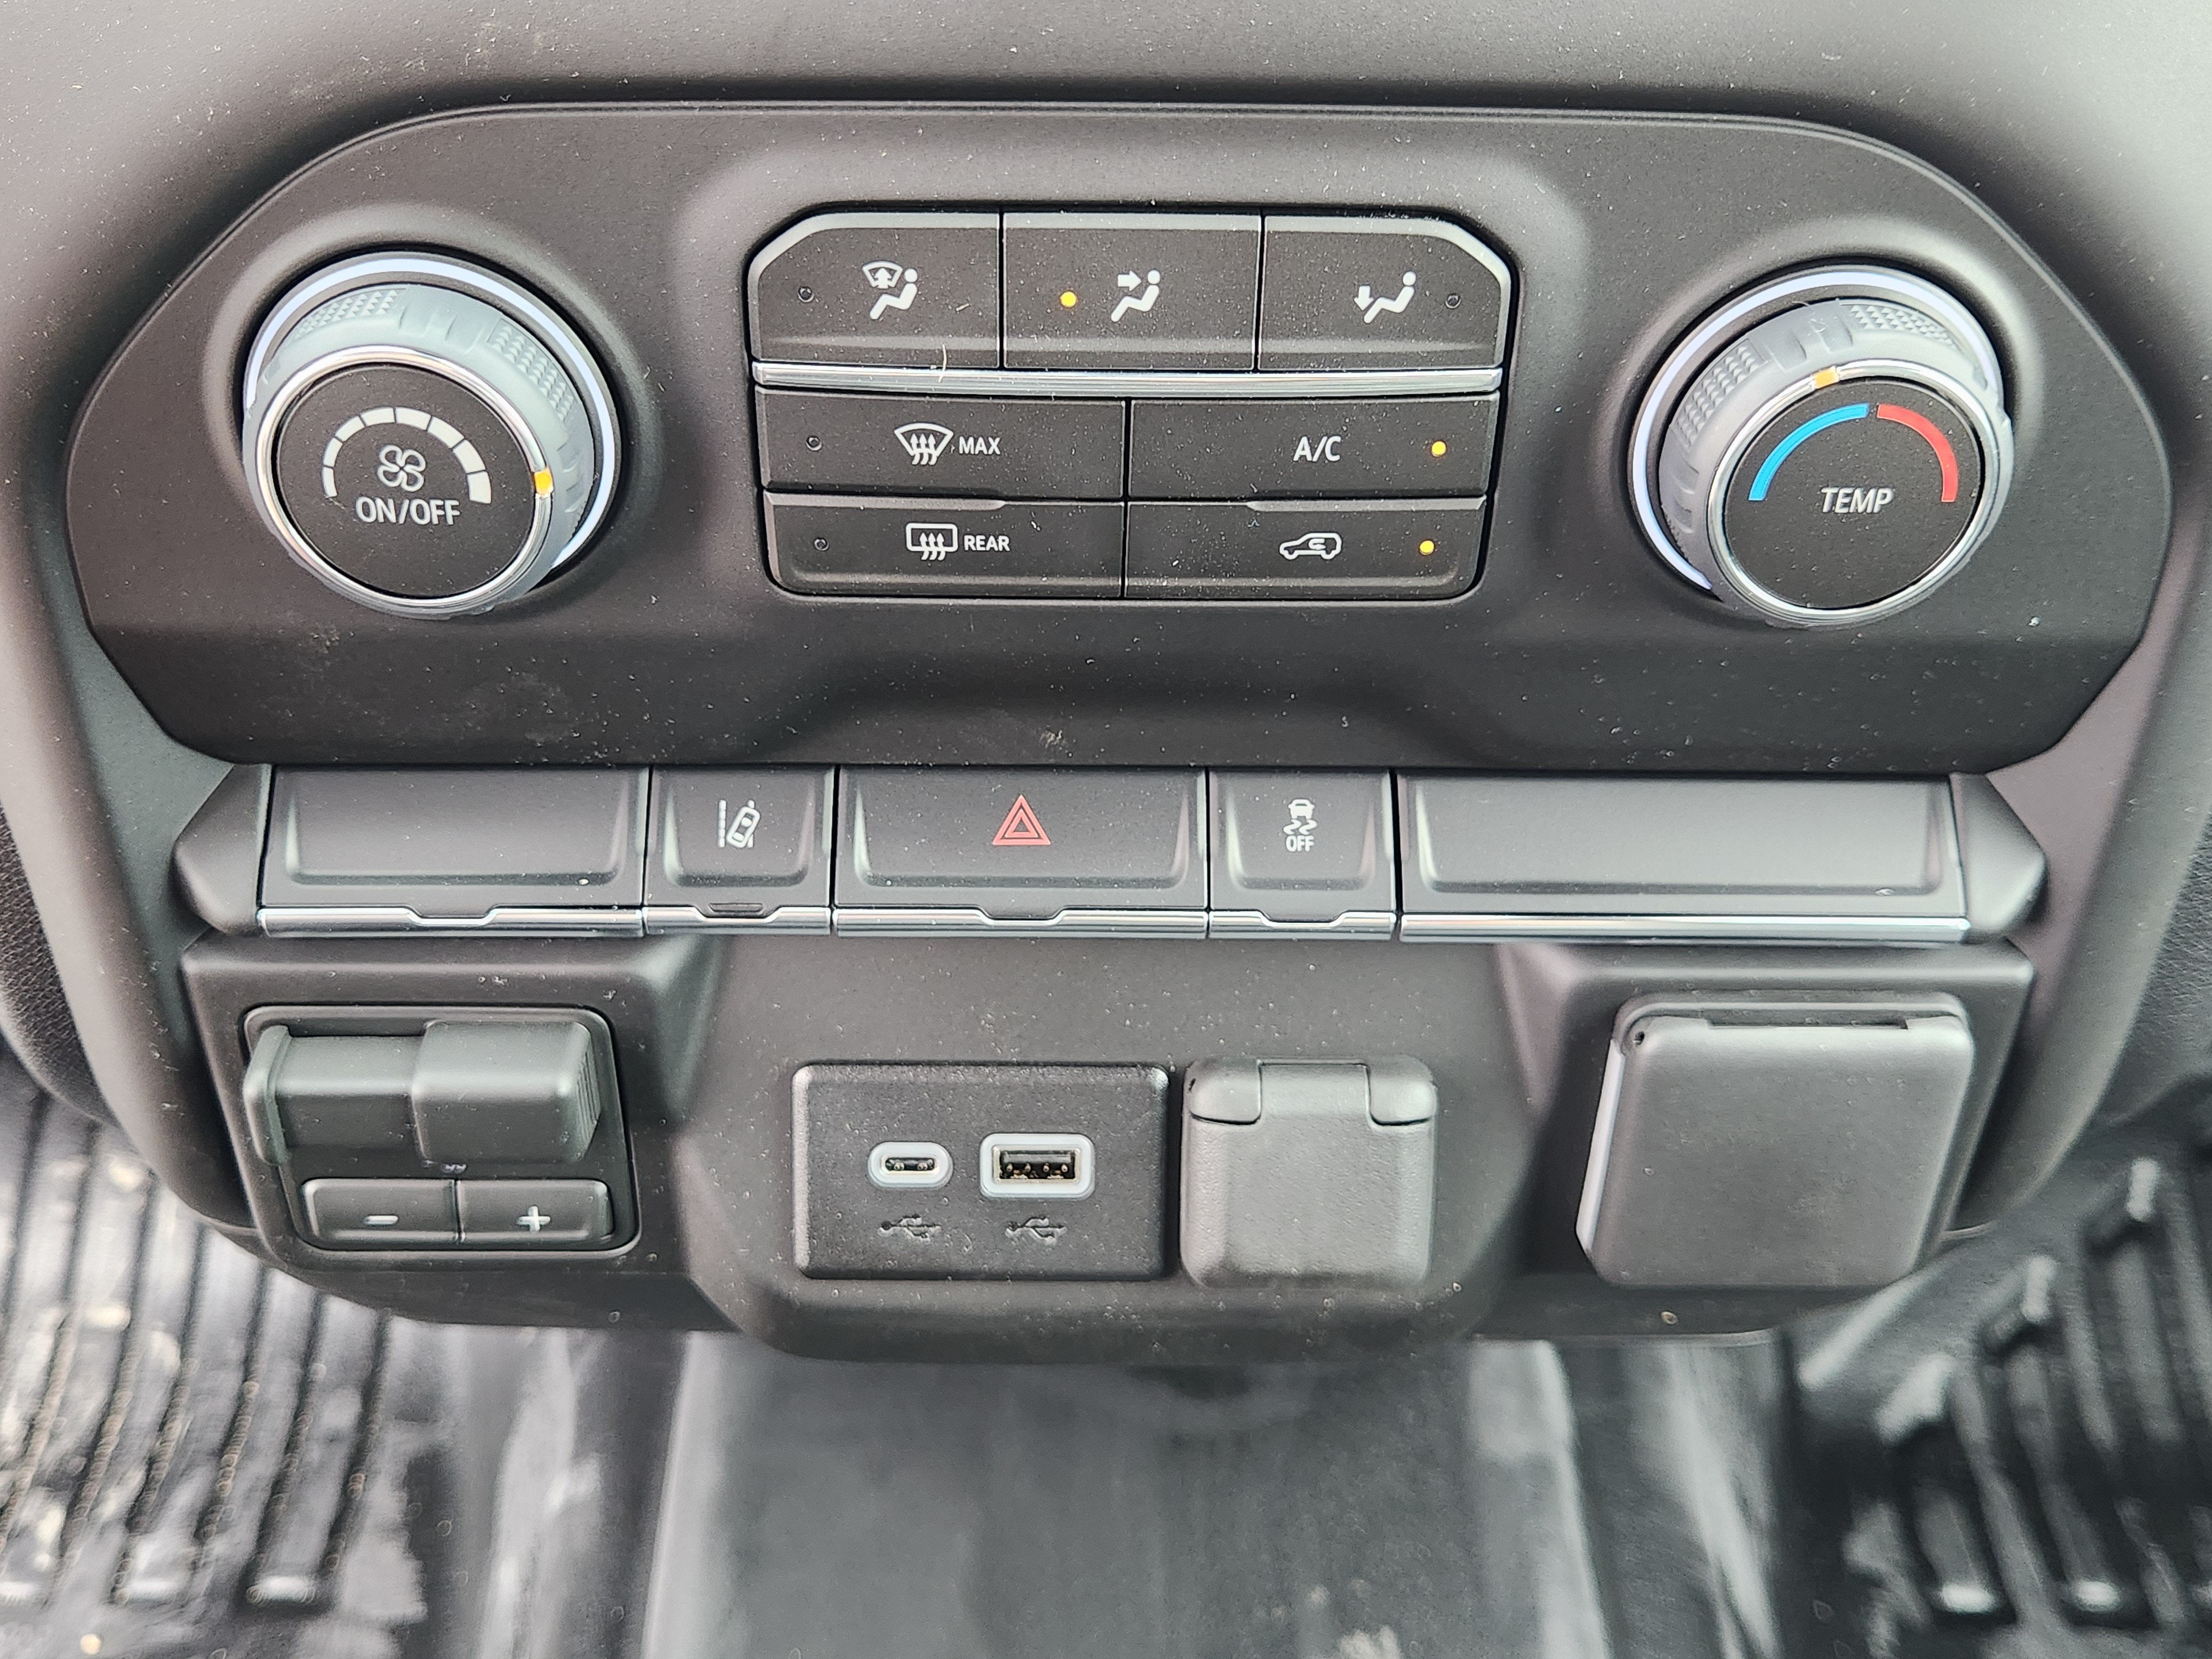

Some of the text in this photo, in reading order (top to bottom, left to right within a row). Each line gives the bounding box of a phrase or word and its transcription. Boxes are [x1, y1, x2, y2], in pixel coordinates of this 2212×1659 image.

[958, 436, 1001, 455] MAX
[1293, 436, 1342, 462] A/C
[356, 497, 460, 525] ON/OFF
[1820, 487, 1893, 514] TEMP
[963, 535, 1011, 552] REAR
[1285, 834, 1315, 852] OFF
